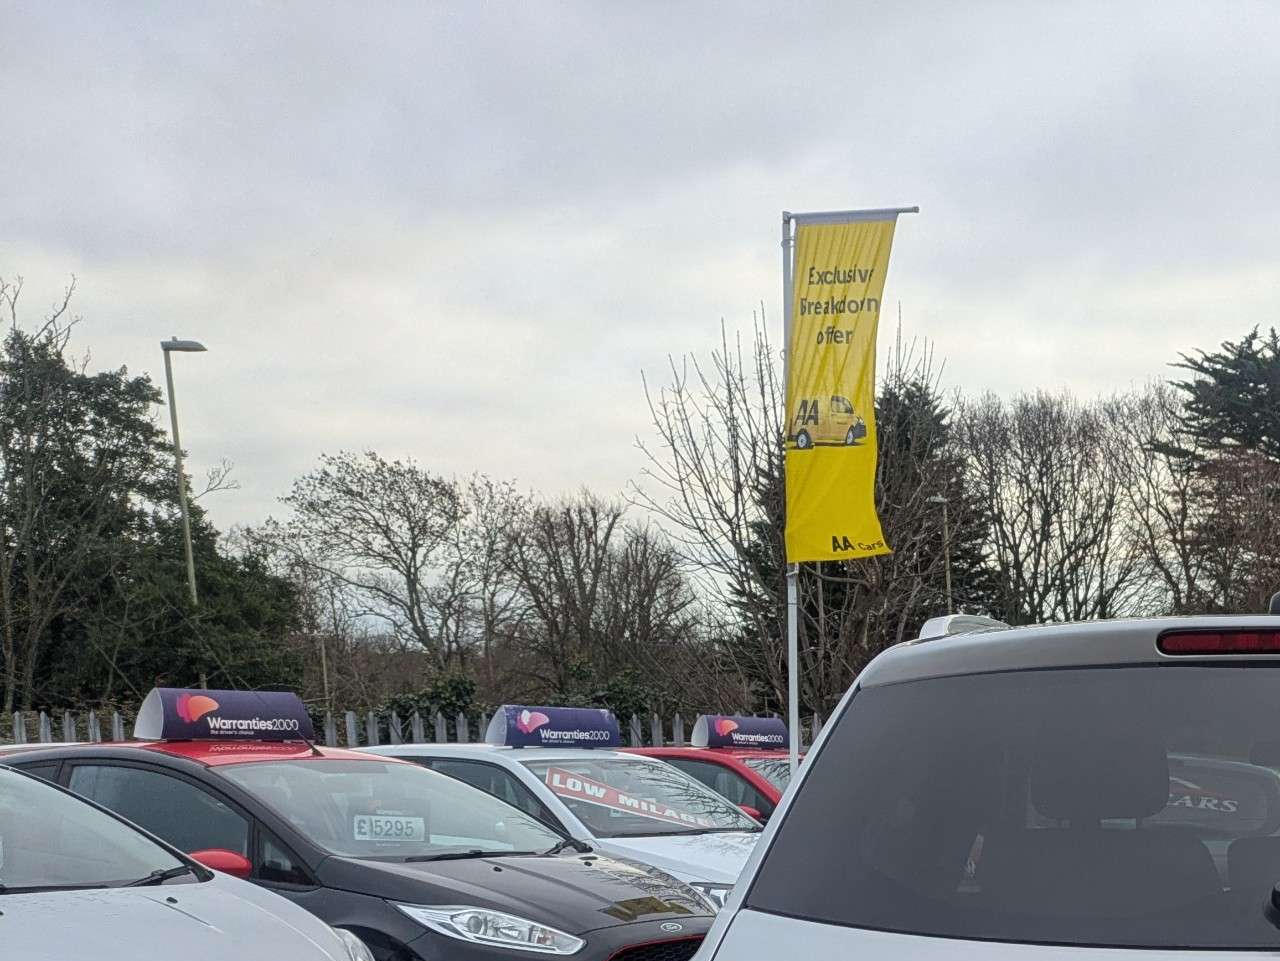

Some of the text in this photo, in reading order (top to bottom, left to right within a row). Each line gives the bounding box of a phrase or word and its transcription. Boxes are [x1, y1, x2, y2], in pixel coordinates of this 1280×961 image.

[800, 296, 879, 316] Breakdon
[816, 326, 853, 345] offer
[795, 399, 819, 426] AA
[832, 535, 884, 553] AA Cars
[207, 717, 299, 731] Warranties2000
[539, 728, 610, 741] Warranties2000
[731, 732, 784, 743] Warranties2000
[552, 773, 607, 799] LOW
[1166, 794, 1239, 813] ARS
